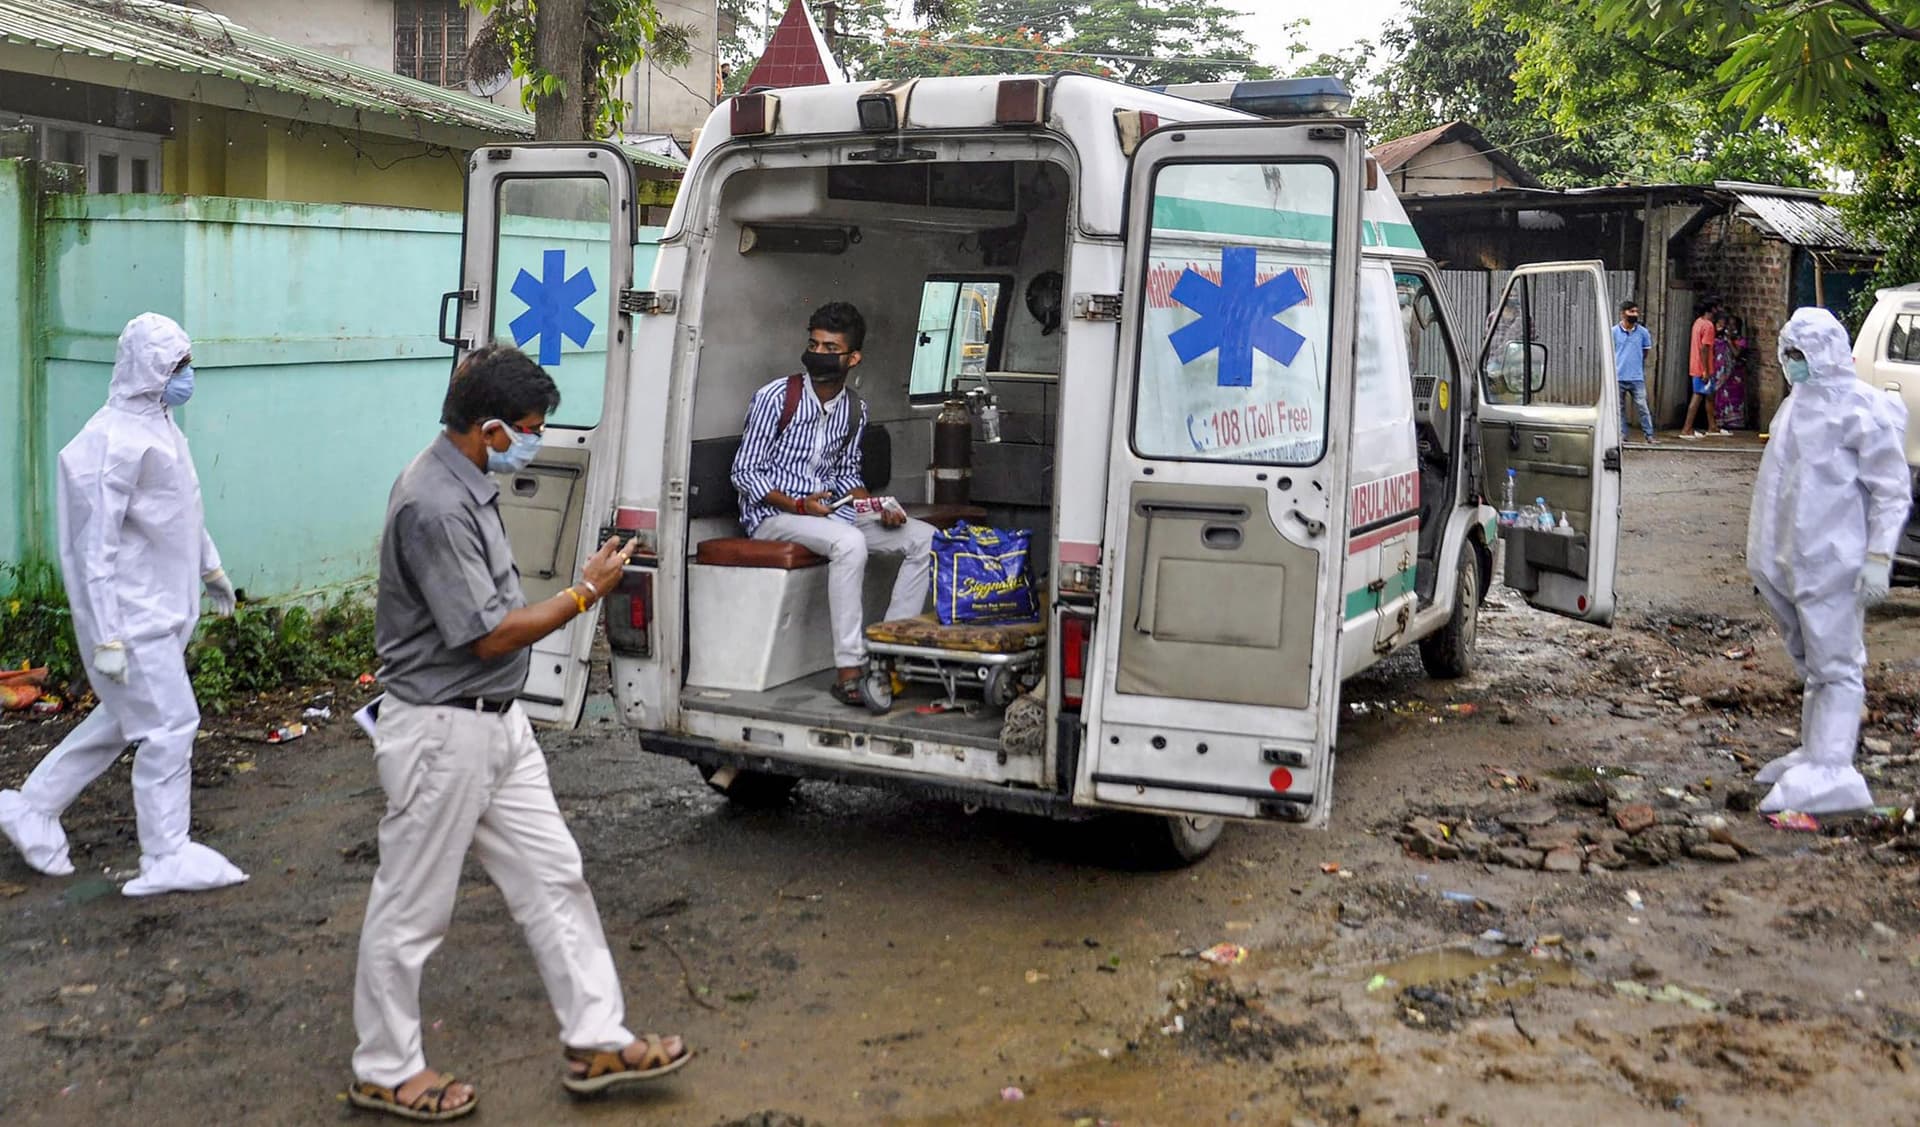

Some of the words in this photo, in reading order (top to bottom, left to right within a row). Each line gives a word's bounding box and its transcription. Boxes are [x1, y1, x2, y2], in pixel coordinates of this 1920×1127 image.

[1212, 409, 1241, 447] 108
[1244, 402, 1275, 443] (Toll
[1277, 398, 1312, 433] Free)
[1351, 473, 1411, 528] MBULANCE
